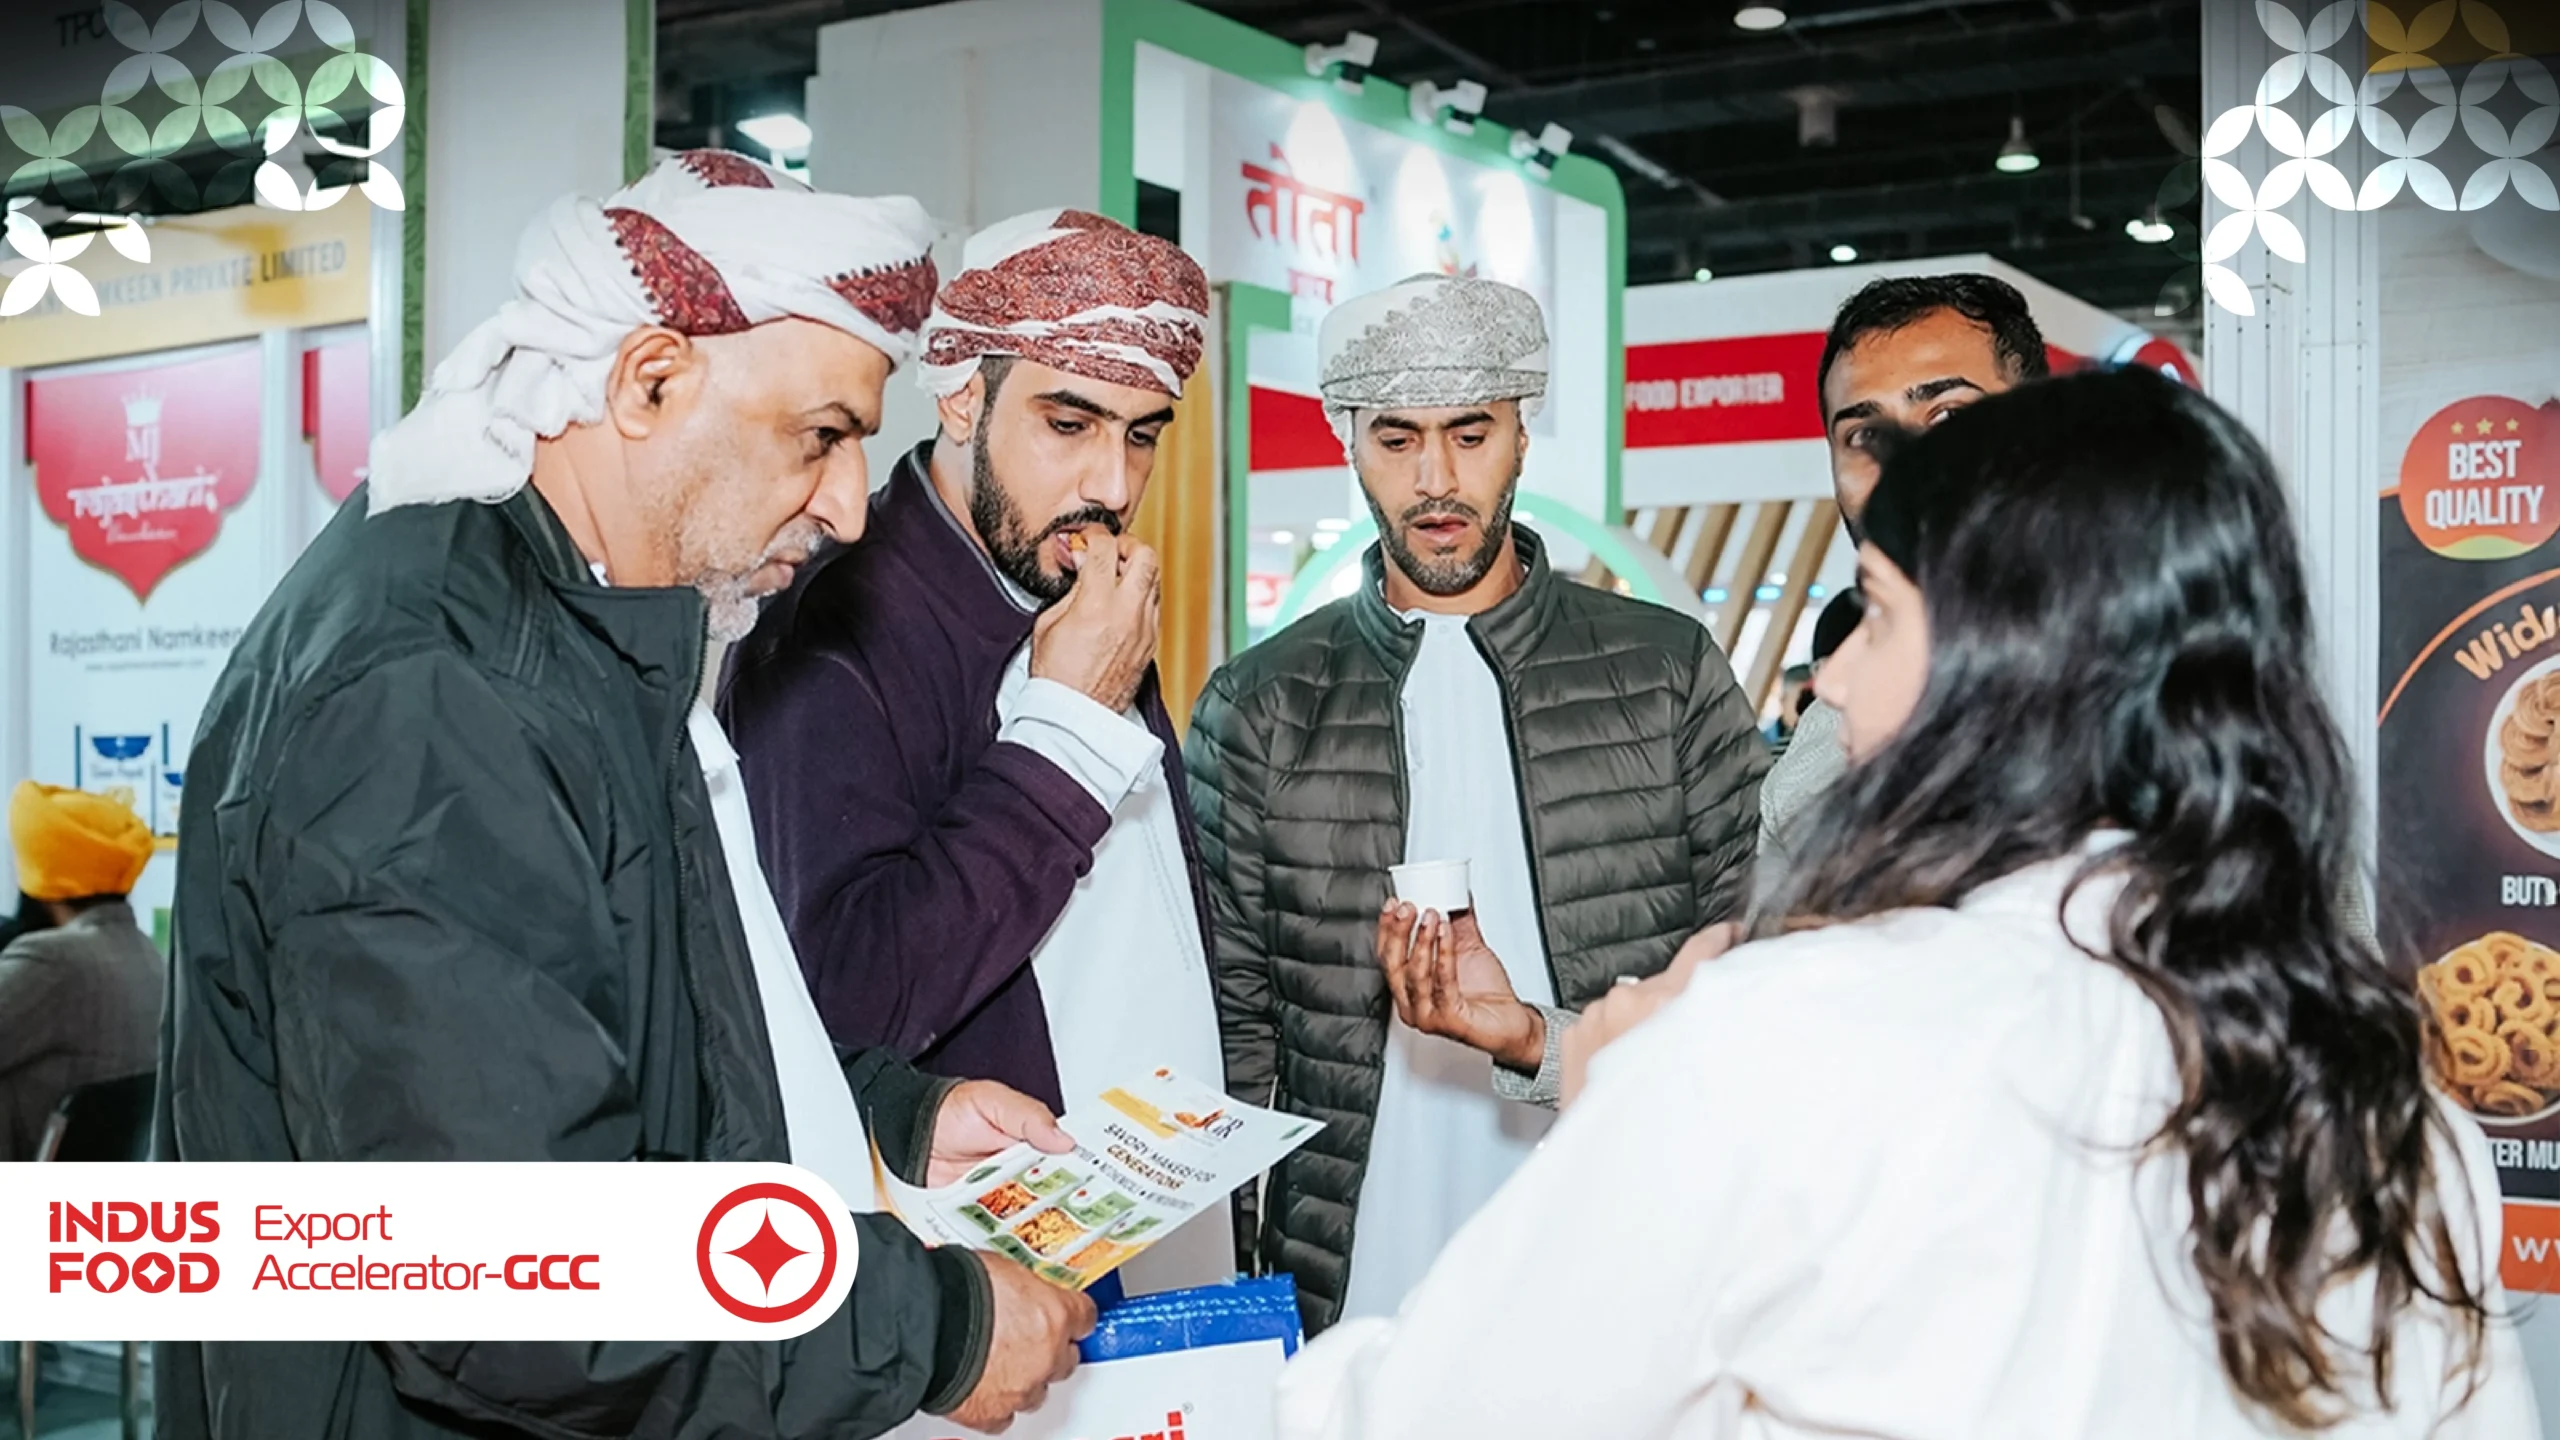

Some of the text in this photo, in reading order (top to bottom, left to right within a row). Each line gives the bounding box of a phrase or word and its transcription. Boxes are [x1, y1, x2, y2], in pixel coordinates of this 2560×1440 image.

[170, 254, 253, 297] PRIVATE
[261, 240, 347, 283] LIMITED
[1680, 371, 1785, 409] EXPORTER
[2448, 439, 2522, 481] BEST
[2425, 485, 2545, 529] QUALITY
